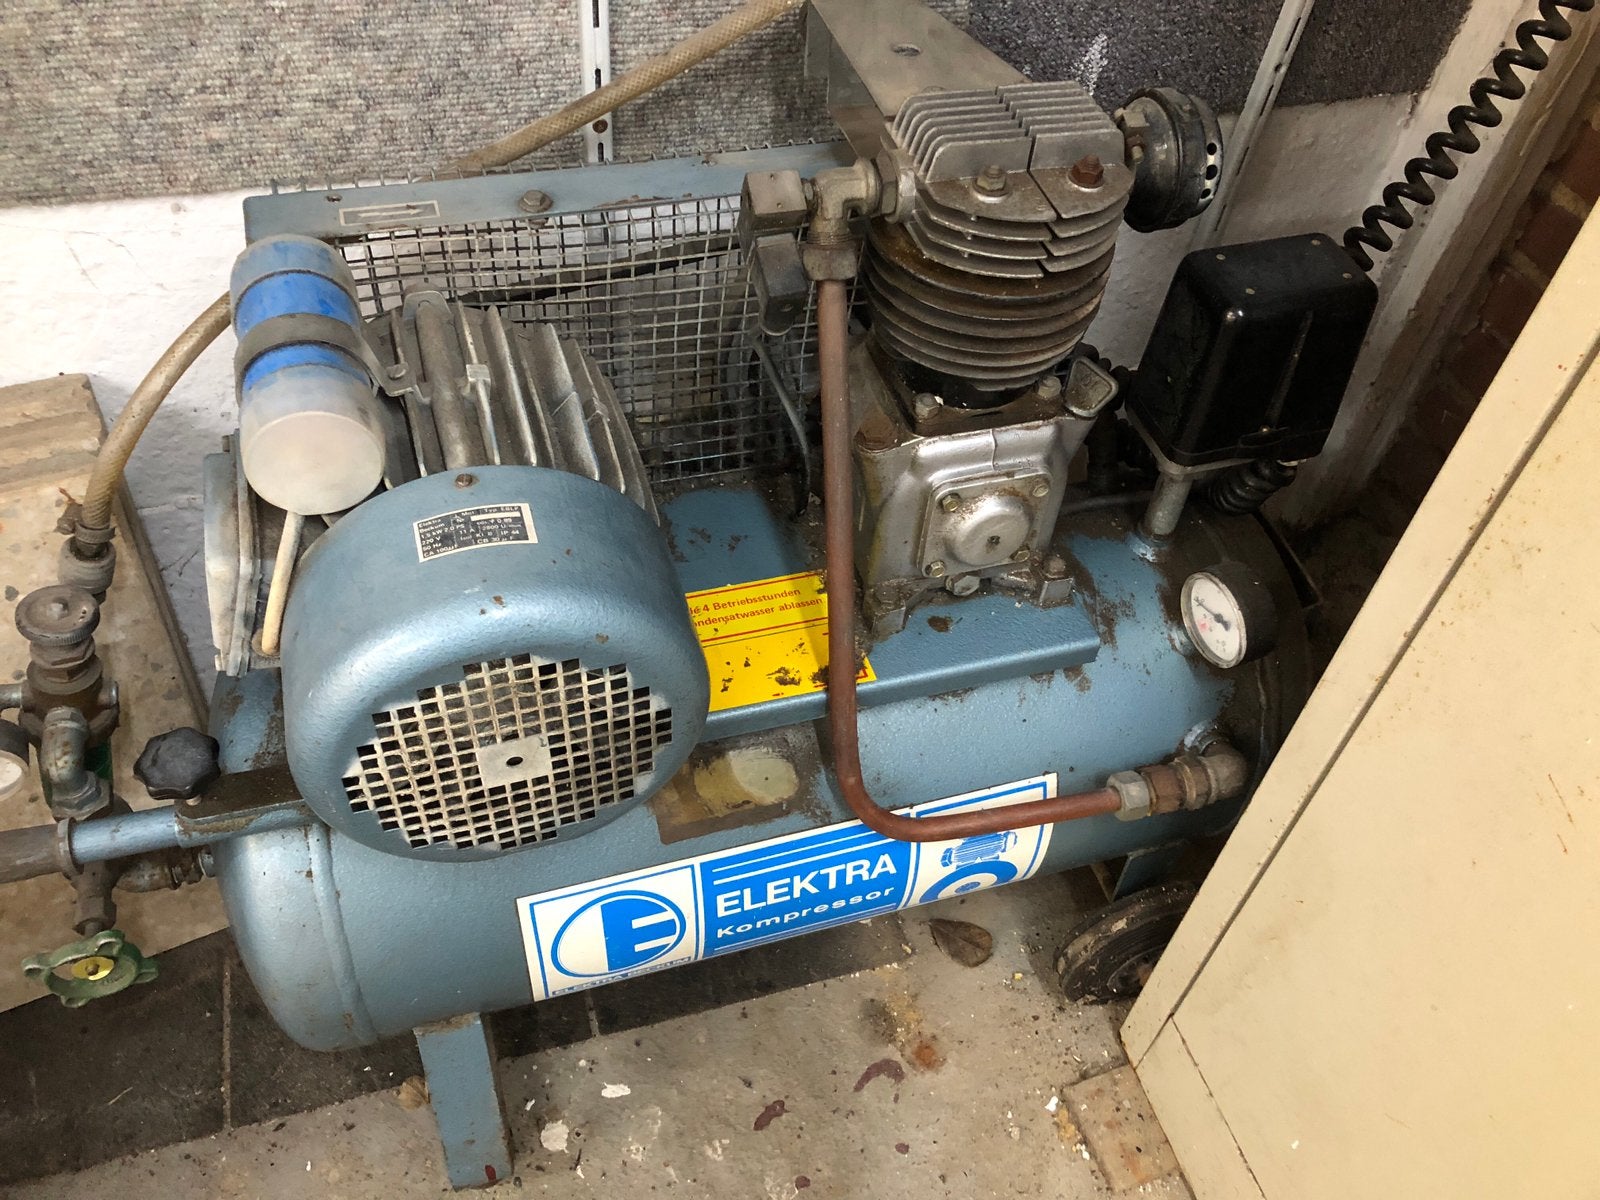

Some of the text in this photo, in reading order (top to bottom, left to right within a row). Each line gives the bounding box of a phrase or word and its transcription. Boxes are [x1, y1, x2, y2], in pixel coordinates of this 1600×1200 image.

[693, 597, 823, 627] ondensatwasser ablassen
[703, 604, 710, 612] 4
[713, 588, 801, 611] Betriebsstunden
[716, 853, 897, 918] ELEKTRA
[717, 887, 895, 938] Kompressor
